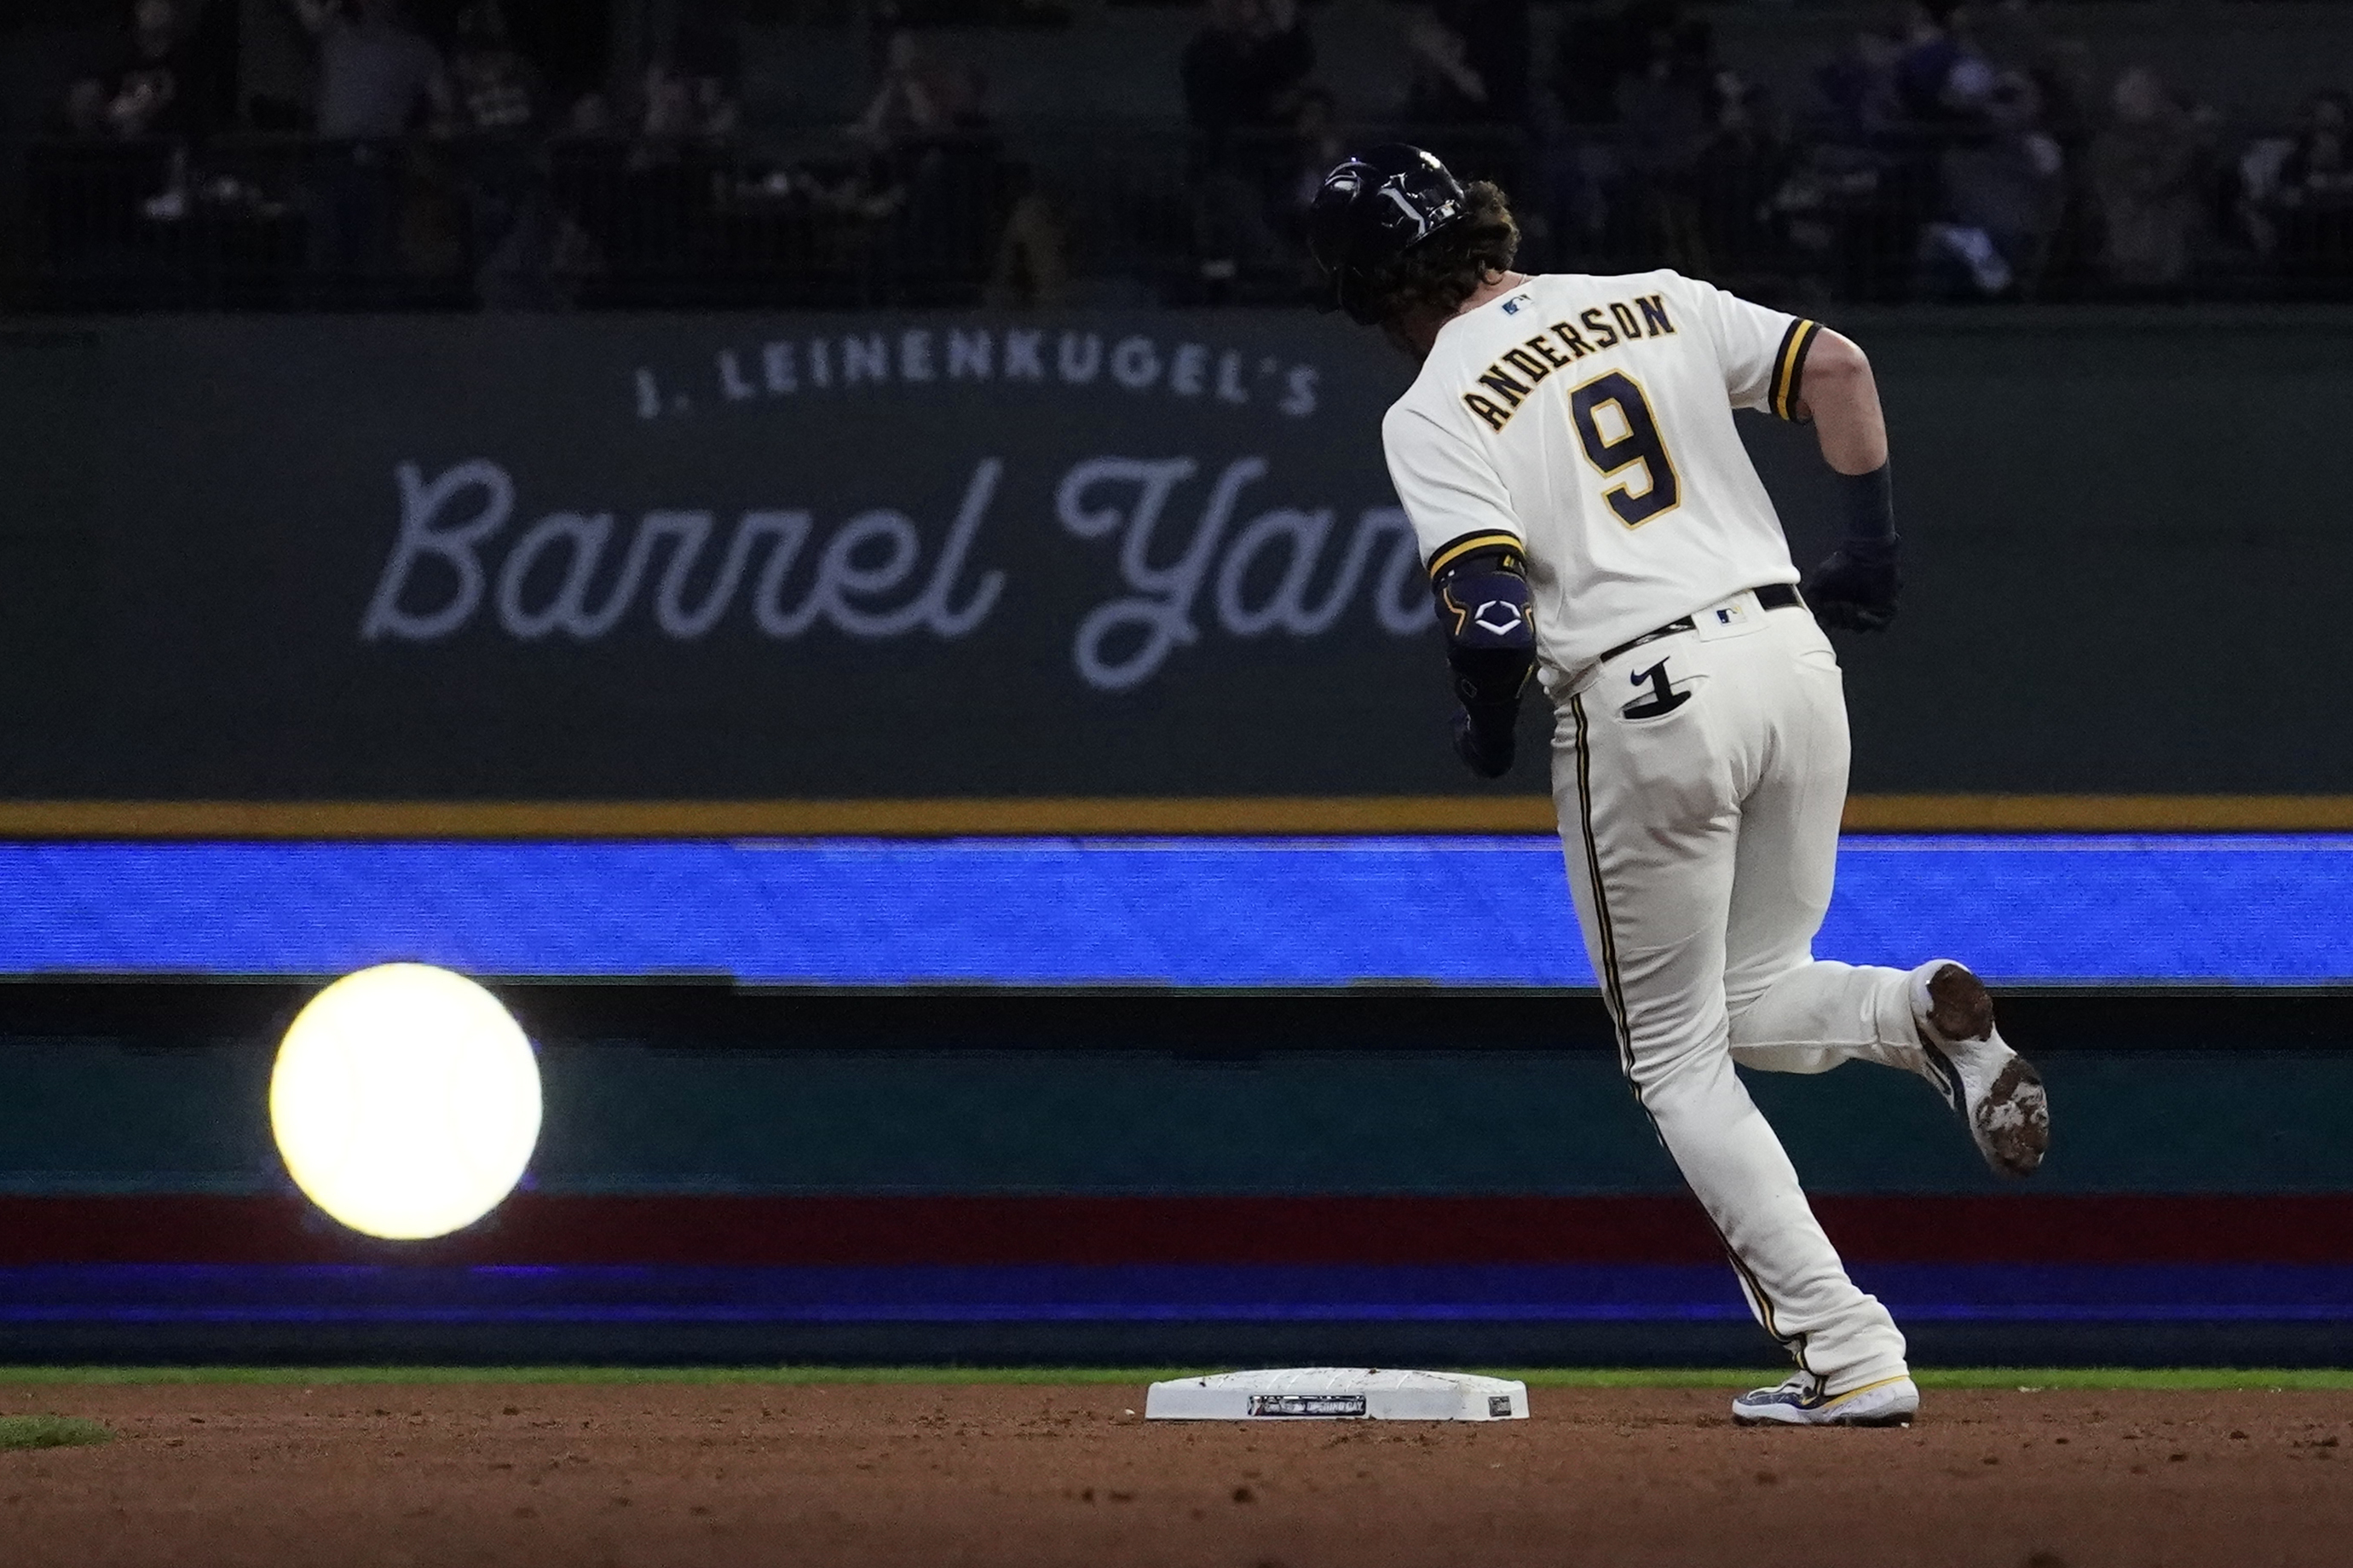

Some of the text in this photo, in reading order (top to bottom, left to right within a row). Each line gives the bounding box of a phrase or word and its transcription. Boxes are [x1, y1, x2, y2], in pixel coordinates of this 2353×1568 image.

[717, 327, 1320, 418] LEINENKUGEL'S
[1459, 294, 1678, 434] ANDERSON
[1567, 367, 1681, 530] 9
[360, 453, 1438, 691] Barrel Yar
